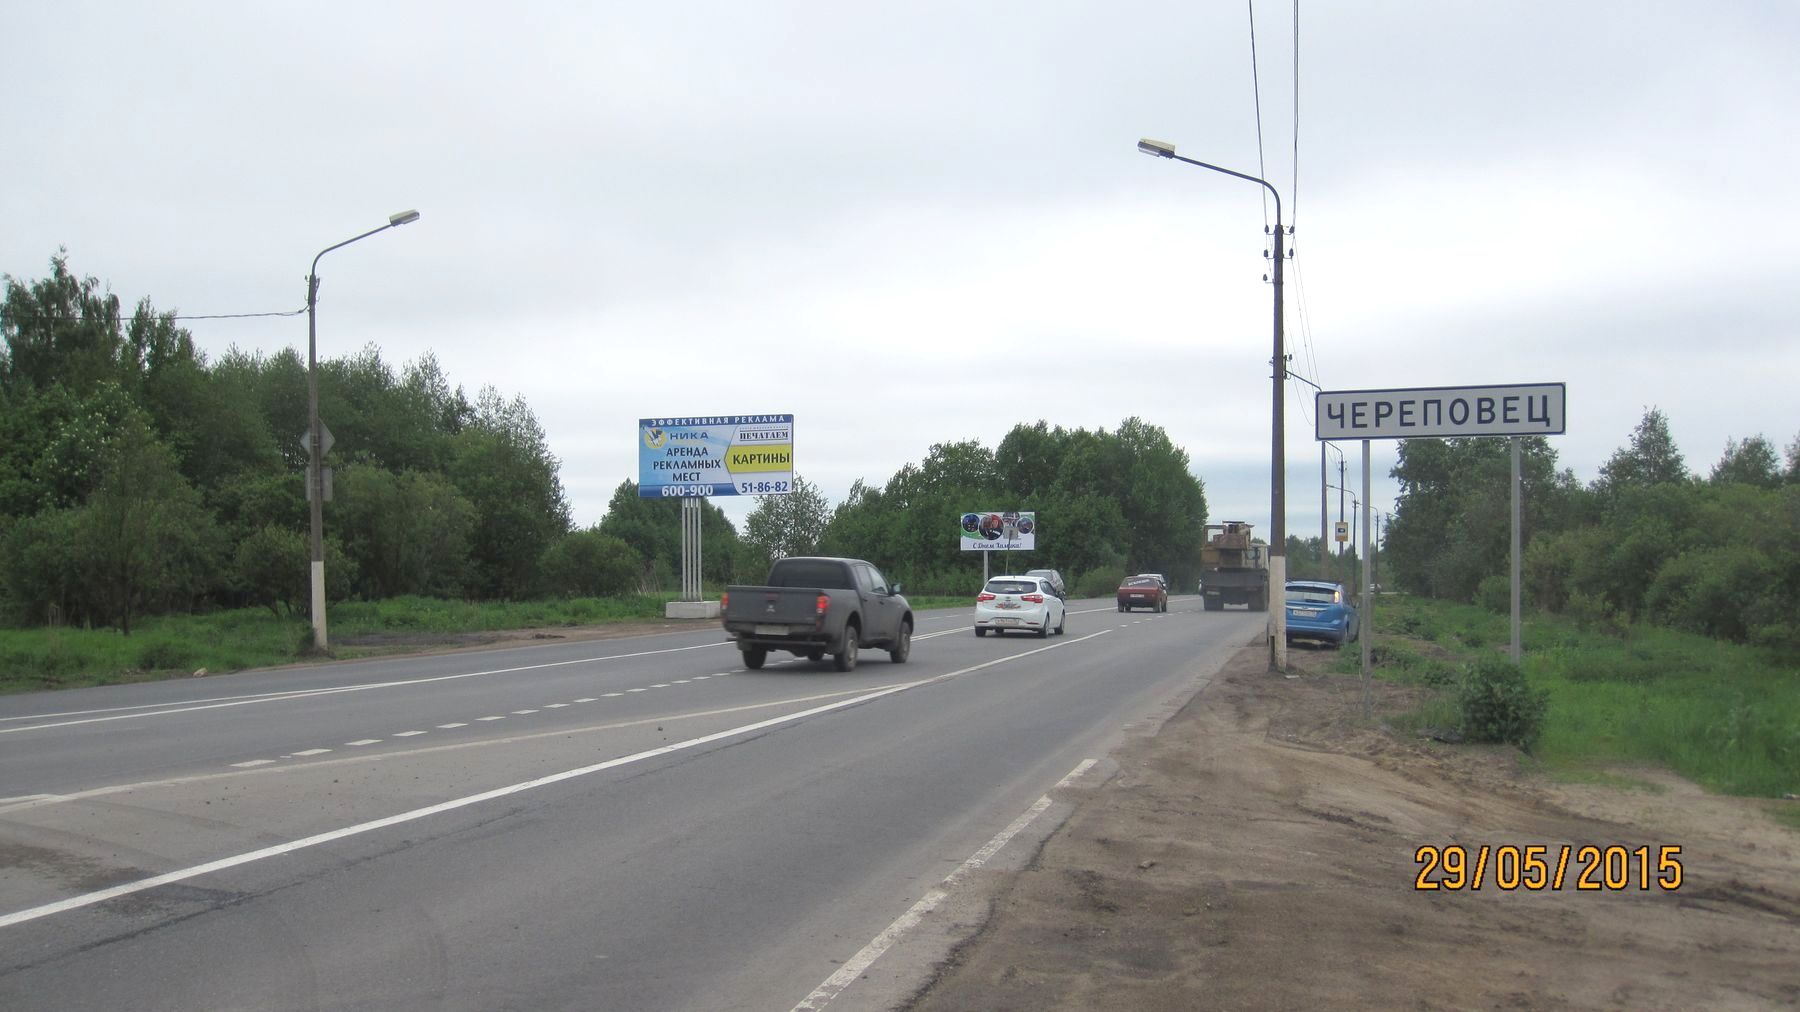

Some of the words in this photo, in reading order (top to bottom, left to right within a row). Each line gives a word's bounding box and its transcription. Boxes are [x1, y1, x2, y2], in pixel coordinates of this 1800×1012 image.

[1327, 395, 1550, 429] ЧЕРЕПОВЕЦ
[651, 417, 729, 427] ЭФФЕКТИВНАЯ
[734, 415, 785, 424] РЕКЛАМА
[669, 431, 709, 440] НИКА
[739, 431, 789, 440] ПЕЧАТАЕМ
[666, 446, 708, 458] АРЕНДА
[653, 459, 721, 470] РЕКЛАМНЫХ
[733, 453, 790, 465] КАРТИНЫ
[672, 472, 701, 482] МЕСТ
[661, 484, 713, 496] 600-900
[741, 481, 788, 493] 51-86-82
